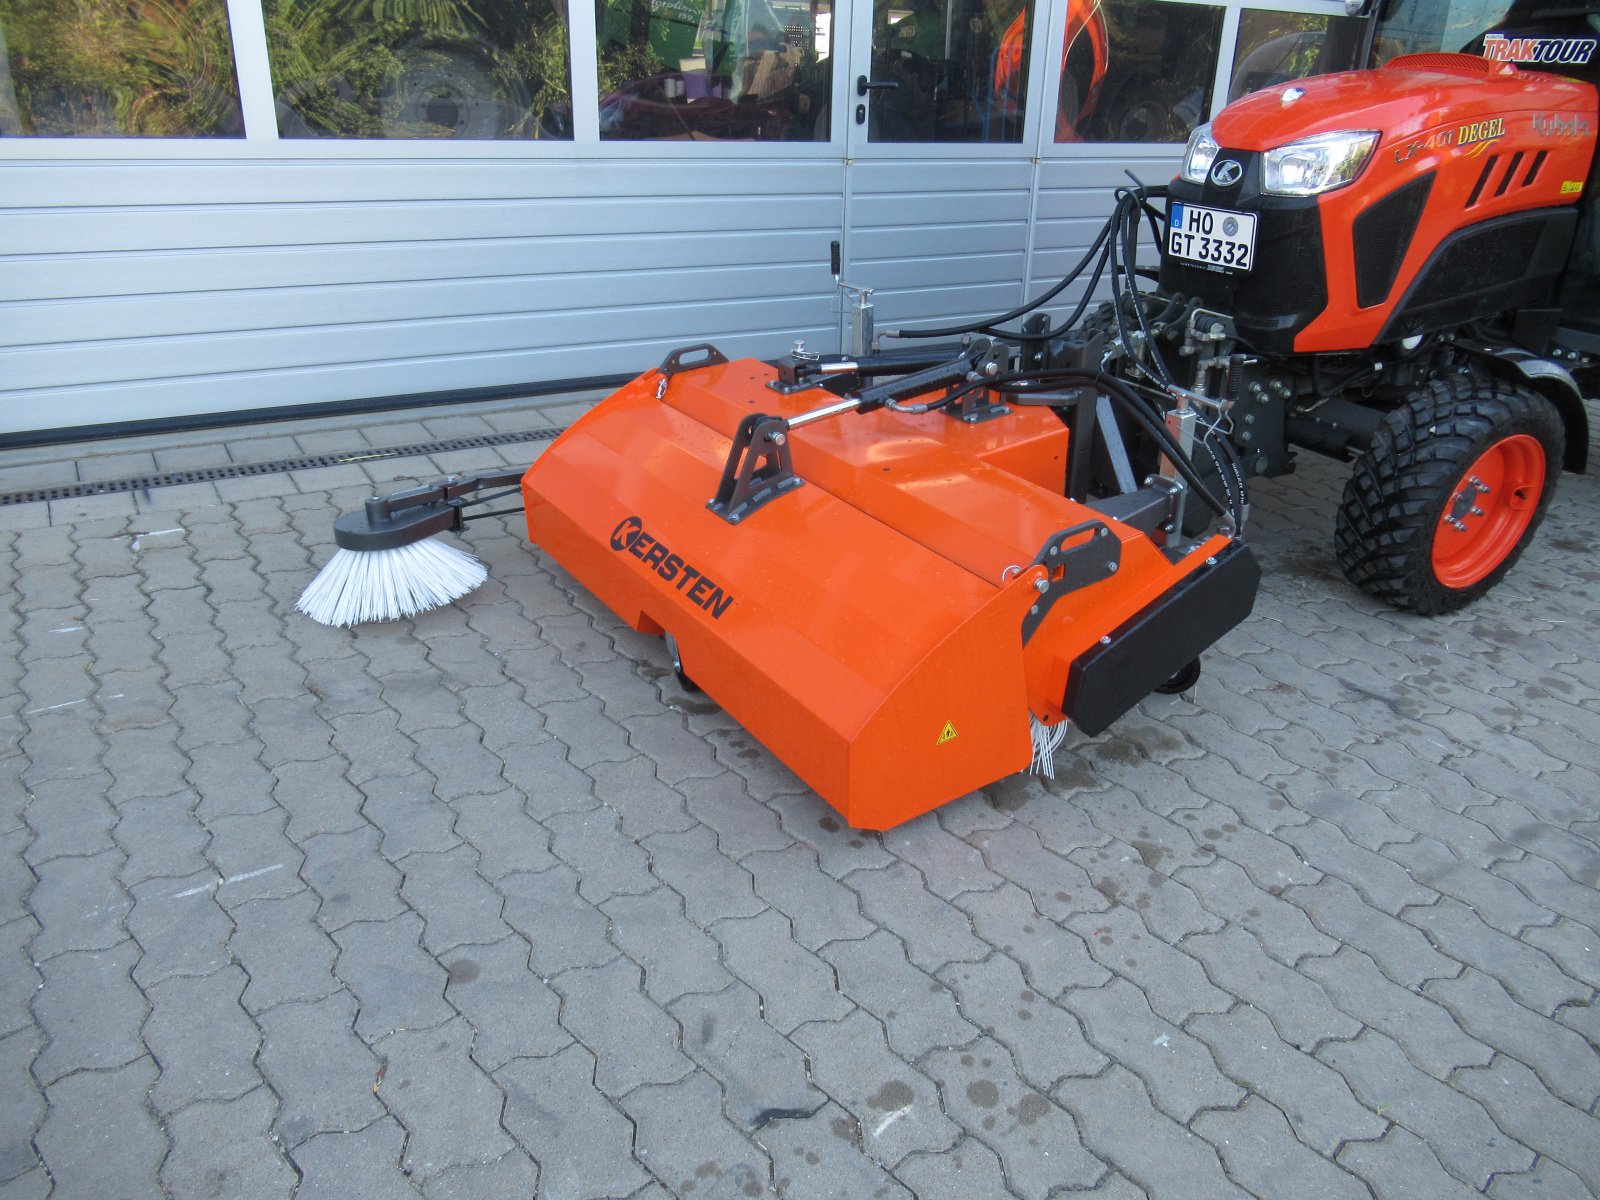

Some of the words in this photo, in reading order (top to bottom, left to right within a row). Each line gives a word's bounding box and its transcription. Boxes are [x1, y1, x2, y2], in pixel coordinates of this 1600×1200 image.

[1483, 39, 1596, 63] TRAKTOUR
[1457, 117, 1506, 146] DEGEL
[1532, 112, 1590, 137] Kubota
[1189, 210, 1213, 235] HO
[1171, 232, 1195, 256] GT
[1198, 237, 1248, 267] 3332
[610, 516, 734, 620] KERSTEN
